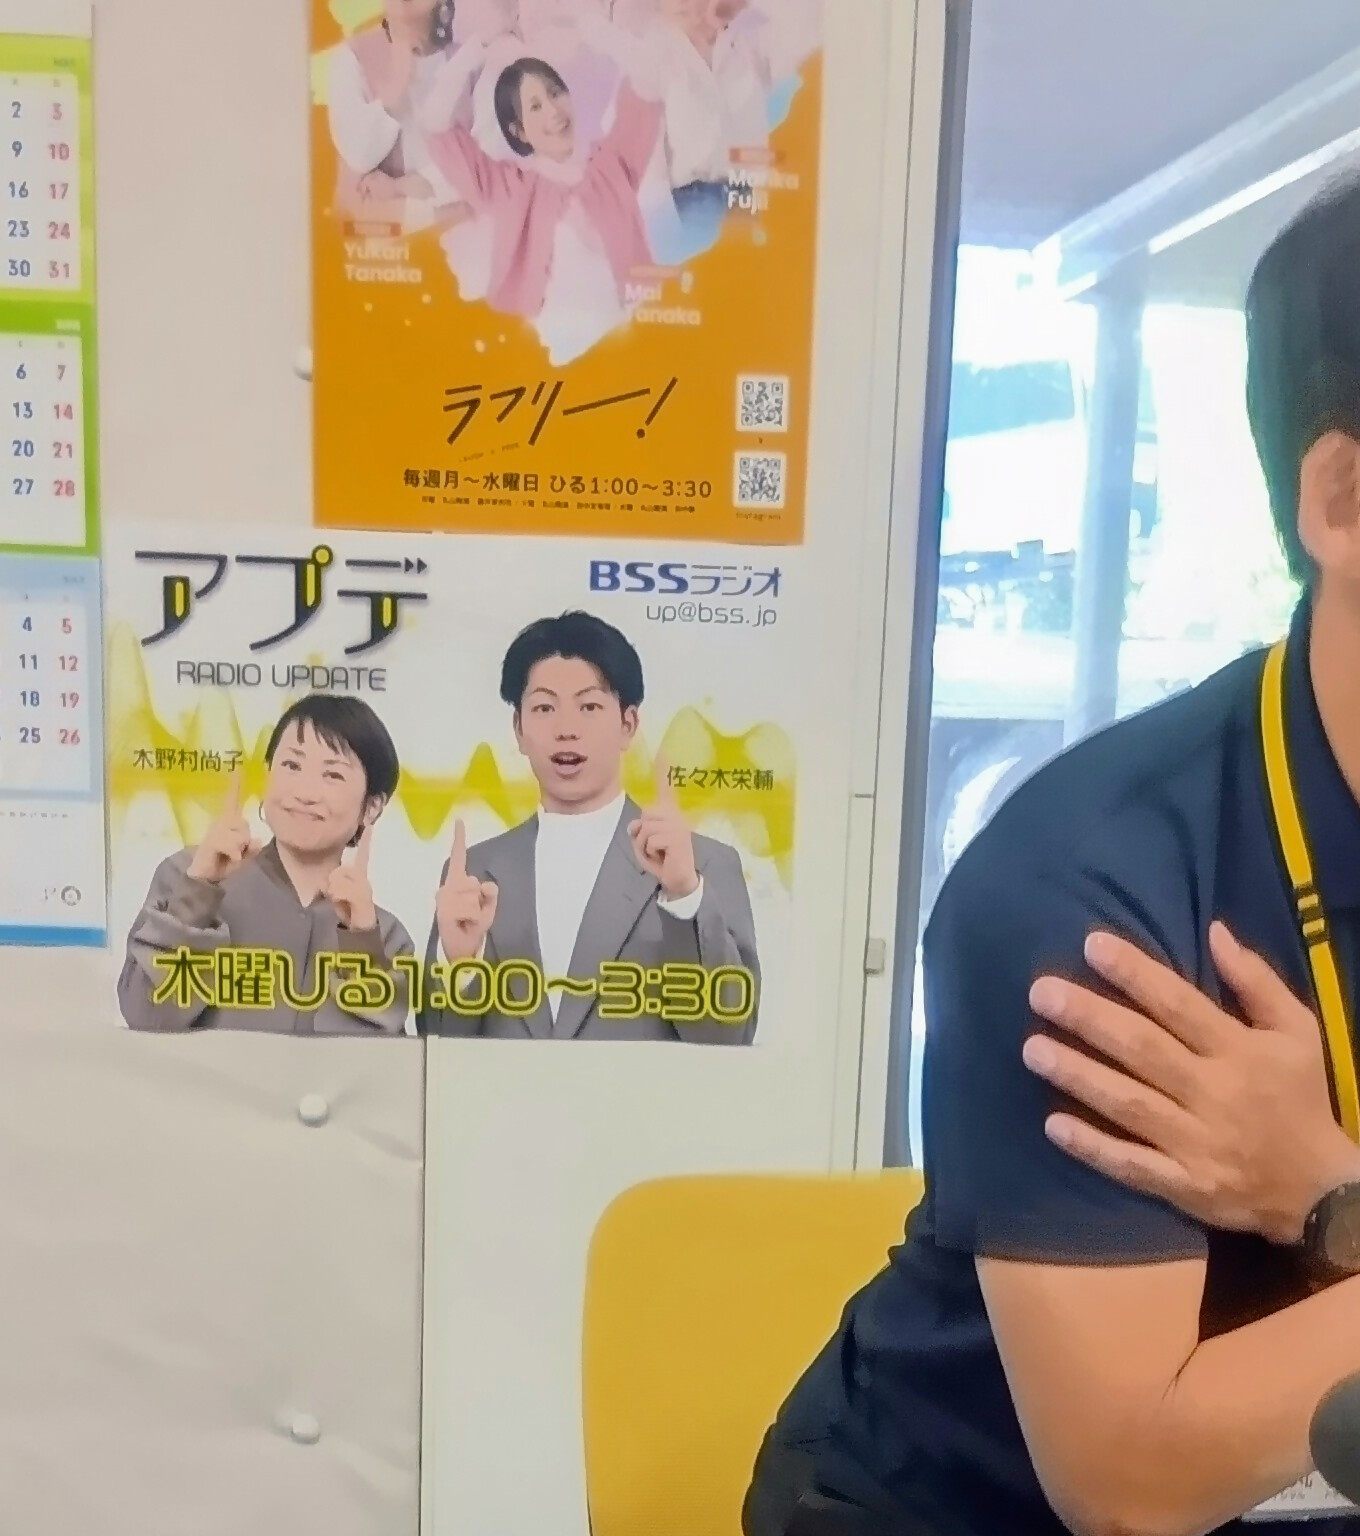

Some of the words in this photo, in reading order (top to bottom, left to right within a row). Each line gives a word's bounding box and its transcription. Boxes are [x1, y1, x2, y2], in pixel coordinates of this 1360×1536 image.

[11, 101, 22, 119] 2
[52, 102, 63, 120] 3
[11, 140, 23, 158] 9
[48, 143, 70, 161] 10
[8, 181, 30, 199] 16
[49, 183, 69, 200] 17
[7, 219, 30, 238] 23
[48, 221, 71, 240] 24
[343, 241, 410, 262] Yukari
[8, 258, 31, 278] 30
[48, 260, 70, 279] 31
[344, 264, 422, 283] Tanaka
[625, 283, 663, 302] Mai
[625, 305, 701, 326] Tanaka
[15, 363, 27, 380] 6
[57, 364, 66, 381] 7
[13, 401, 33, 420] 13
[53, 403, 74, 420] 14
[12, 440, 35, 458] 20
[52, 441, 73, 459] 21
[12, 478, 35, 496] 27
[53, 479, 76, 498] 28
[588, 560, 782, 598] BSSラジオ
[134, 543, 429, 656] アプデ
[22, 616, 33, 632] 4
[61, 618, 73, 634] 5
[645, 603, 778, 628] up@bss.jp
[19, 653, 38, 670] 11
[59, 655, 79, 672] 12
[176, 660, 262, 687] RADIO
[270, 663, 388, 692] UPDATE
[20, 690, 41, 708] 18
[60, 692, 80, 709] 19
[19, 726, 41, 744] 25
[59, 728, 81, 745] 26
[133, 747, 244, 773] 木野村尚子
[666, 765, 775, 791] 佐々木栄輔
